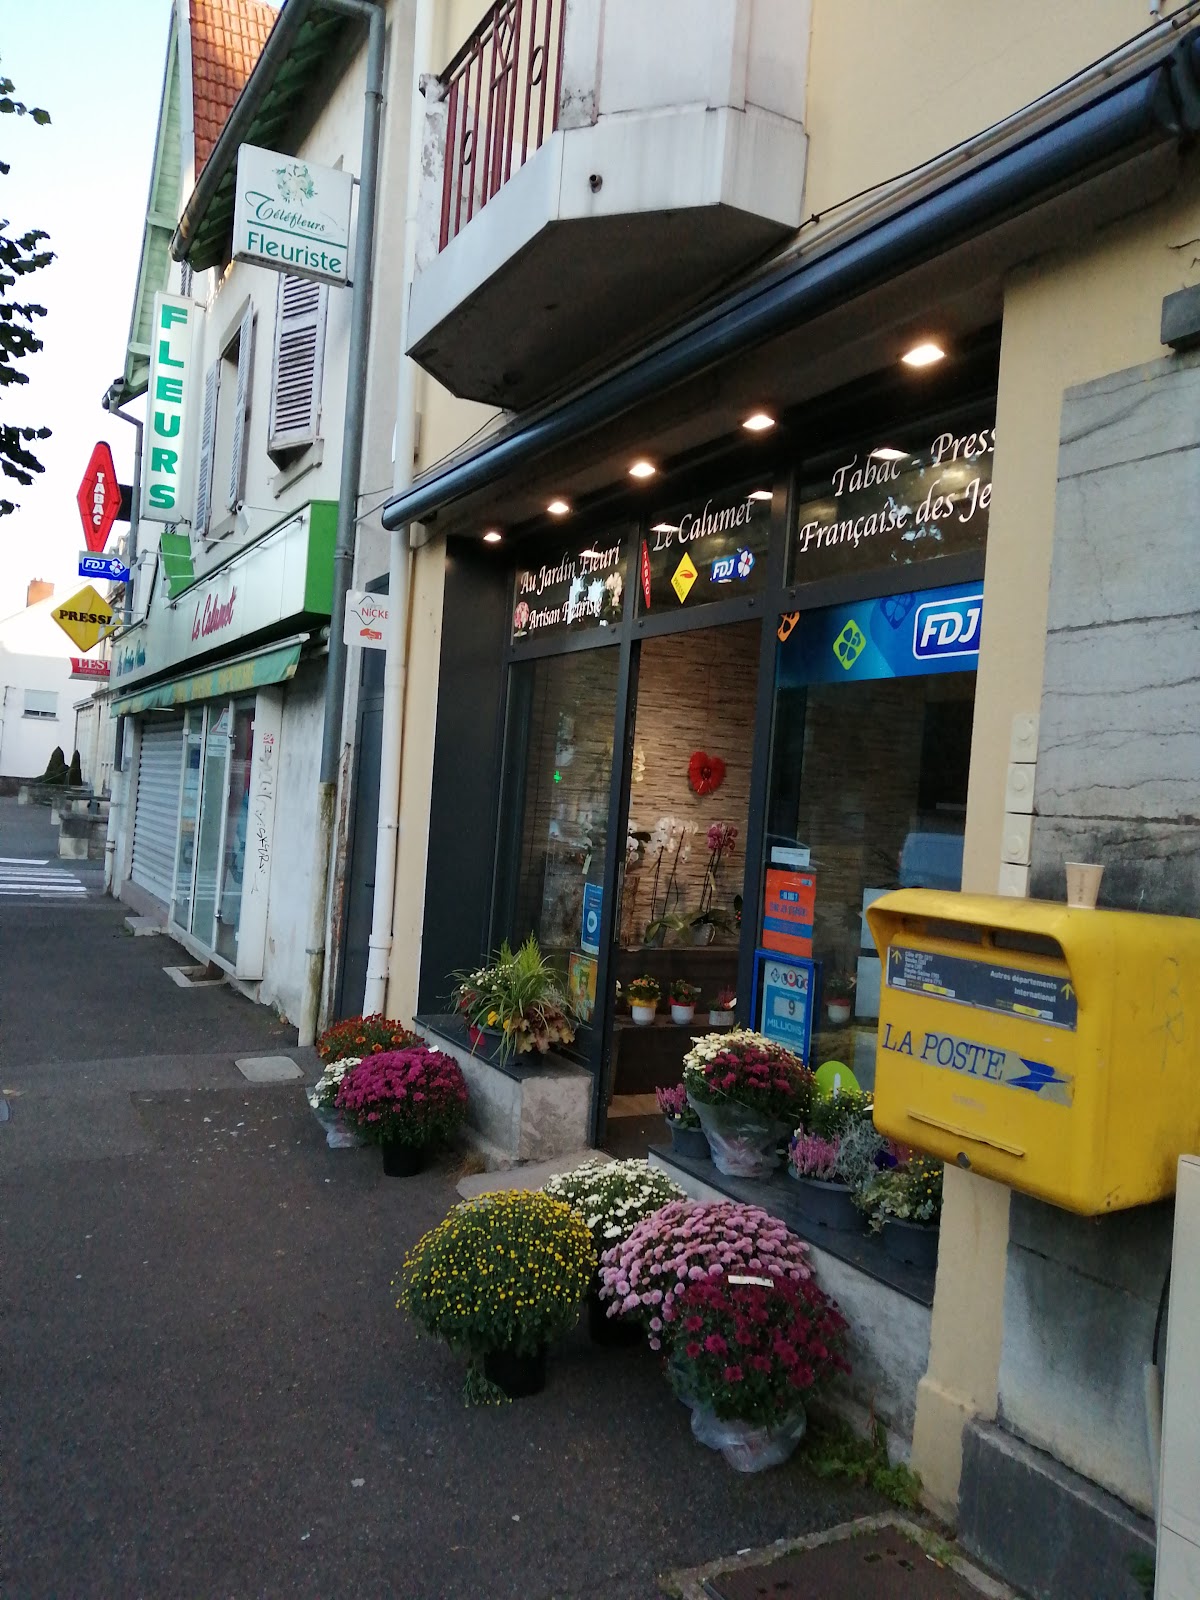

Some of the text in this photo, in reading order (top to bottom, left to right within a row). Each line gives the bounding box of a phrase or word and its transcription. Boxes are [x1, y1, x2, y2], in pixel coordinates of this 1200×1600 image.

[245, 191, 325, 231] Téléfleurs
[247, 231, 342, 273] Fleuriste
[149, 303, 189, 510] FLEURS
[832, 447, 902, 497] Tabac
[92, 472, 106, 526] TABAC
[799, 477, 993, 553] Française des Je
[652, 499, 755, 552] Le Calumet
[85, 559, 106, 570] FDJ
[520, 538, 622, 596] Au Jardin Fleuri
[712, 558, 735, 580] FDJ
[528, 606, 561, 630] Artisan
[920, 607, 981, 649] FDJ
[990, 970, 1057, 990] Autres départements
[1014, 987, 1057, 1003] International
[788, 1000, 796, 1016] 9
[881, 1023, 1007, 1081] LA POSTE
